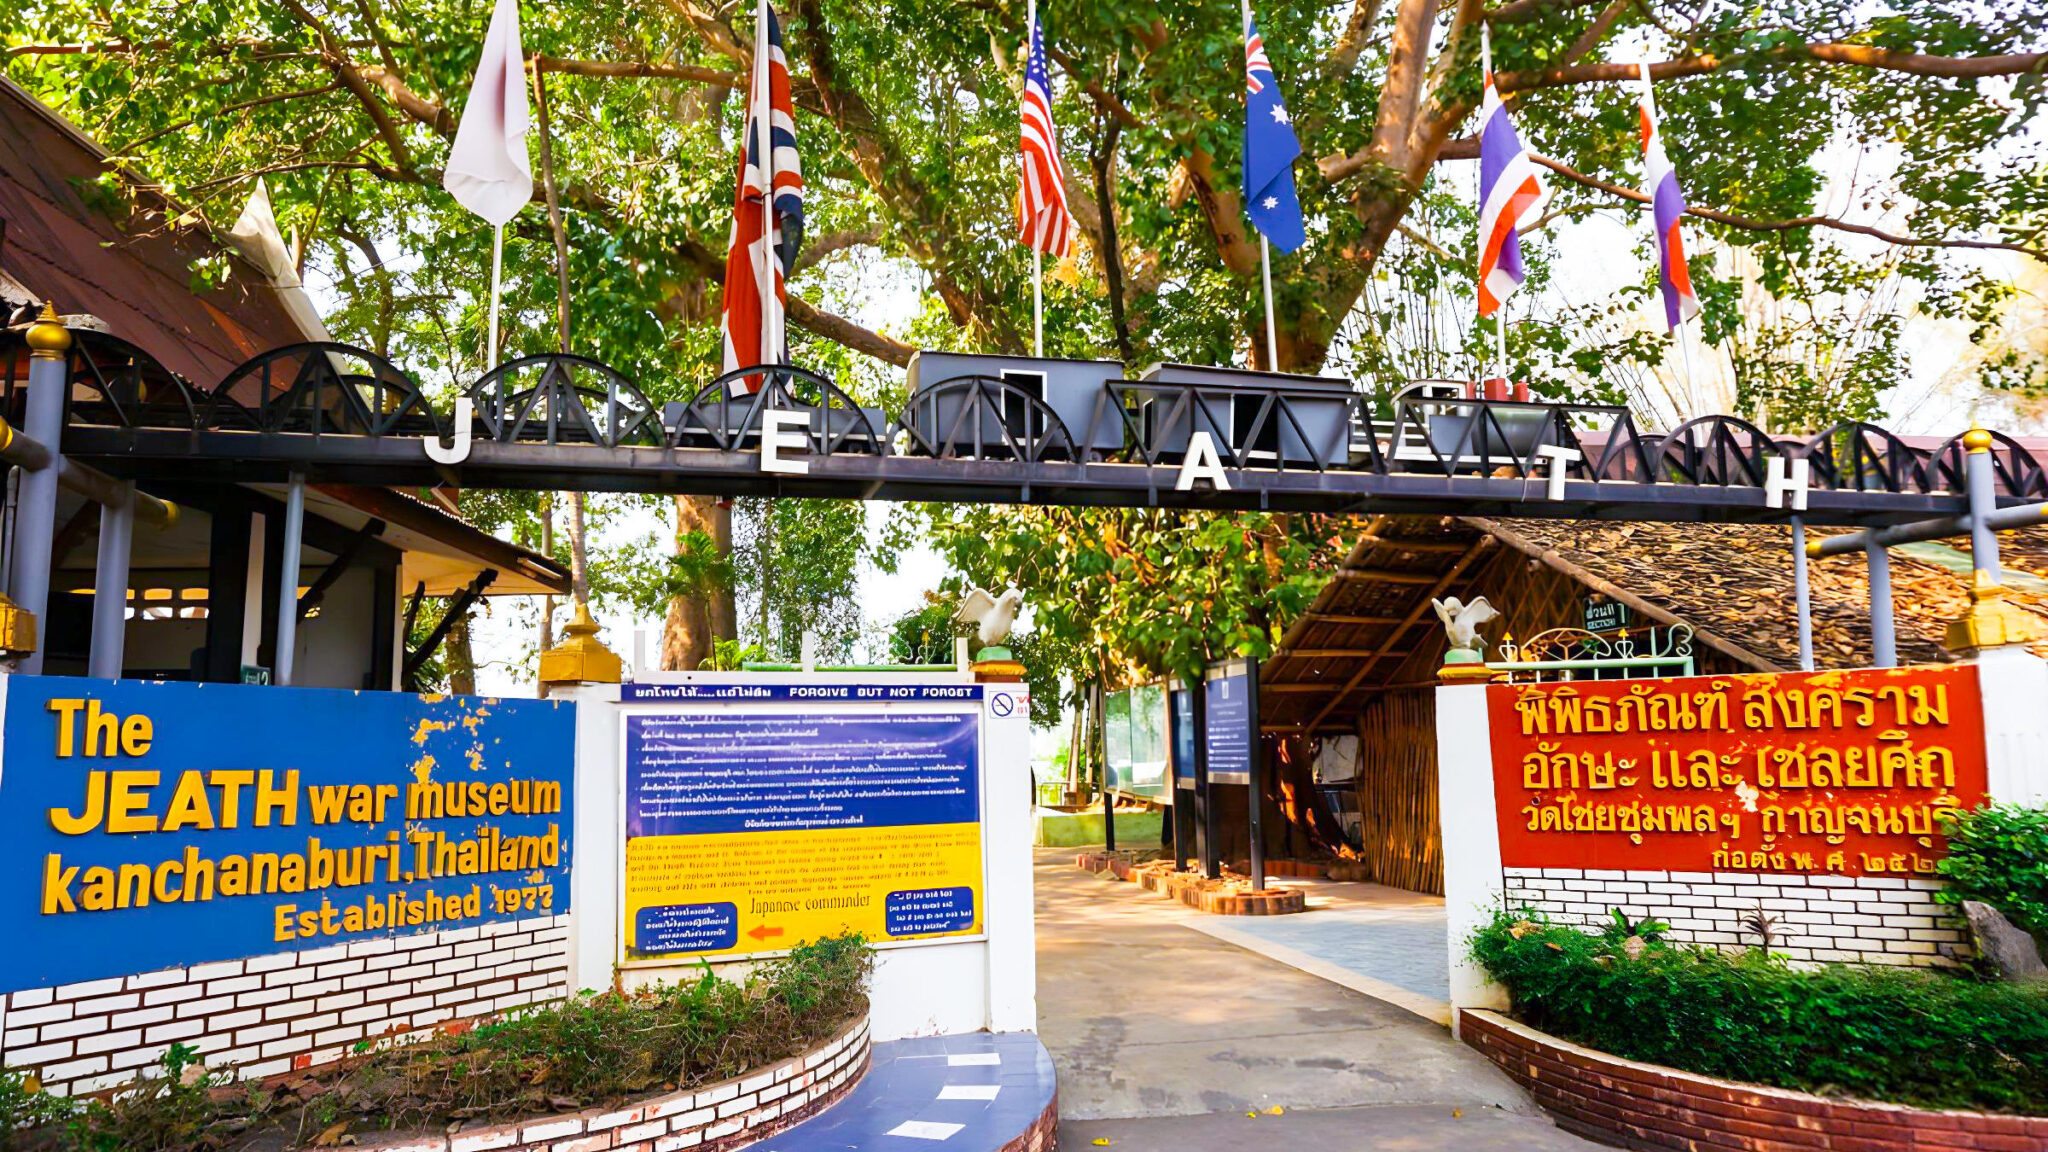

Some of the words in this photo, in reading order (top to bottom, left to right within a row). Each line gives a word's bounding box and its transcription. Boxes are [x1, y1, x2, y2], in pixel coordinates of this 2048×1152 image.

[789, 687, 848, 697] FORGIVE
[857, 687, 883, 697] BUT
[889, 687, 917, 697] NOT
[922, 687, 973, 697] FORGET
[1515, 680, 1731, 735] พิพิธภัณฑ์
[1742, 684, 1949, 728] สงคราม
[46, 698, 153, 758] The
[1522, 741, 1640, 790] อักษะ
[1651, 749, 1744, 789] และ
[1757, 729, 1956, 788] เชลยศึก
[48, 769, 300, 836] JEATH
[308, 784, 398, 825] war
[405, 780, 561, 820] museum
[1858, 851, 1936, 873] ๒๕๒
[273, 885, 481, 942] Established
[494, 885, 553, 914] 1977
